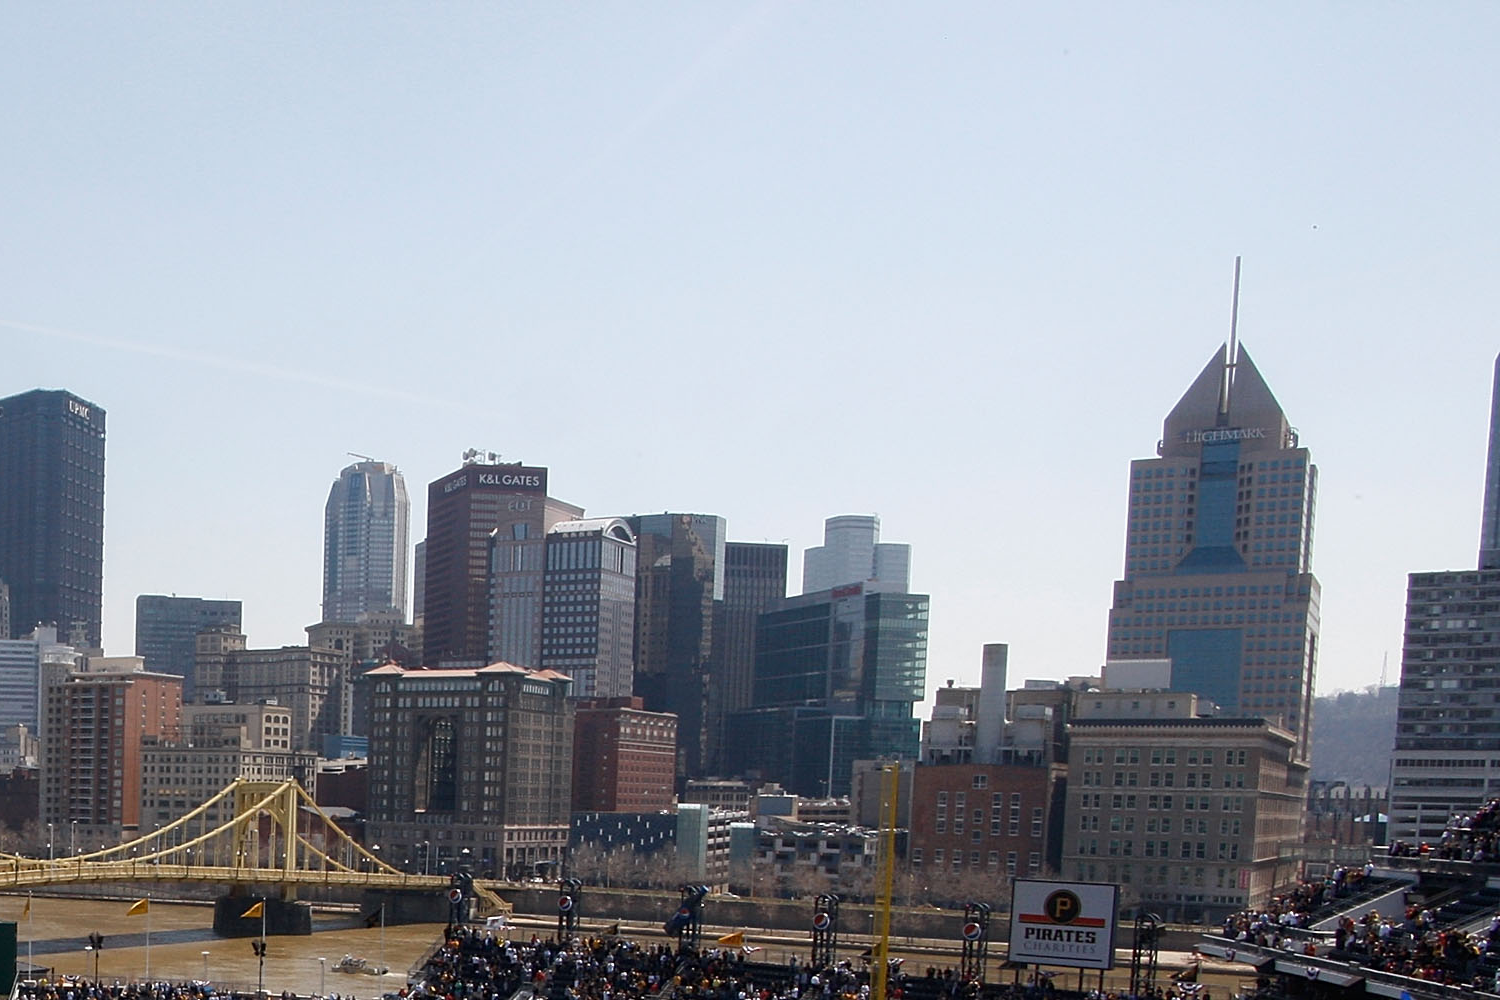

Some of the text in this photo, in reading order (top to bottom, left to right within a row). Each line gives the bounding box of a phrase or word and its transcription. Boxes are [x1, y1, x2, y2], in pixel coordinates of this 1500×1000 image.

[69, 400, 90, 420] UPMC
[1185, 428, 1265, 443] HIGHMARK
[479, 474, 540, 486] K&L GATES
[1056, 897, 1072, 917] P
[1024, 927, 1096, 944] PIRATES
[1023, 941, 1096, 954] CHARITIES
